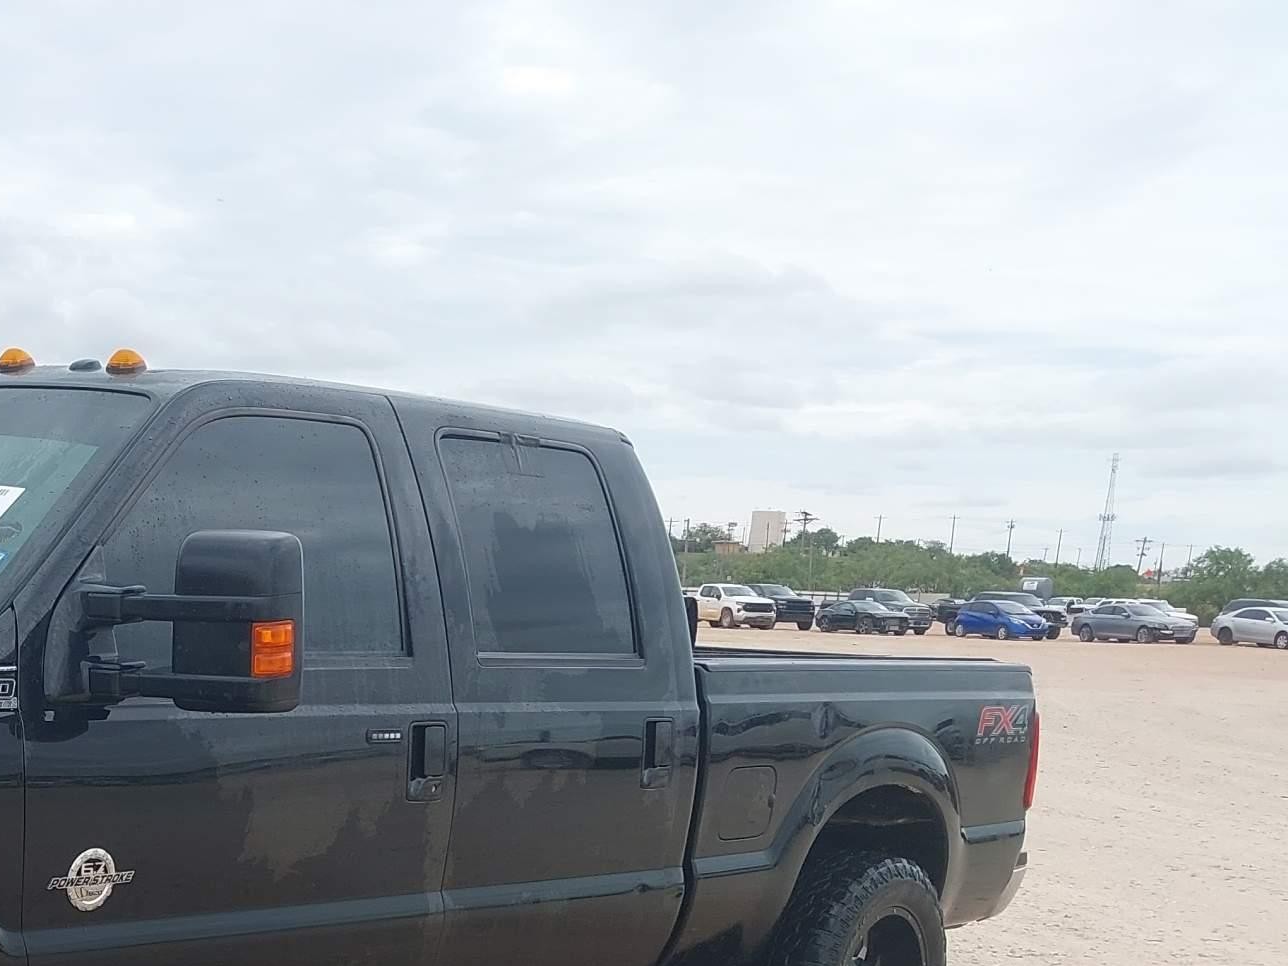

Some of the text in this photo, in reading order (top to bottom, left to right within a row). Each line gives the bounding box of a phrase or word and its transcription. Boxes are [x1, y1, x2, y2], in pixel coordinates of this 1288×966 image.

[977, 704, 1030, 736] FX4
[81, 861, 106, 876] 6.7
[47, 870, 136, 890] POWER STROKE
